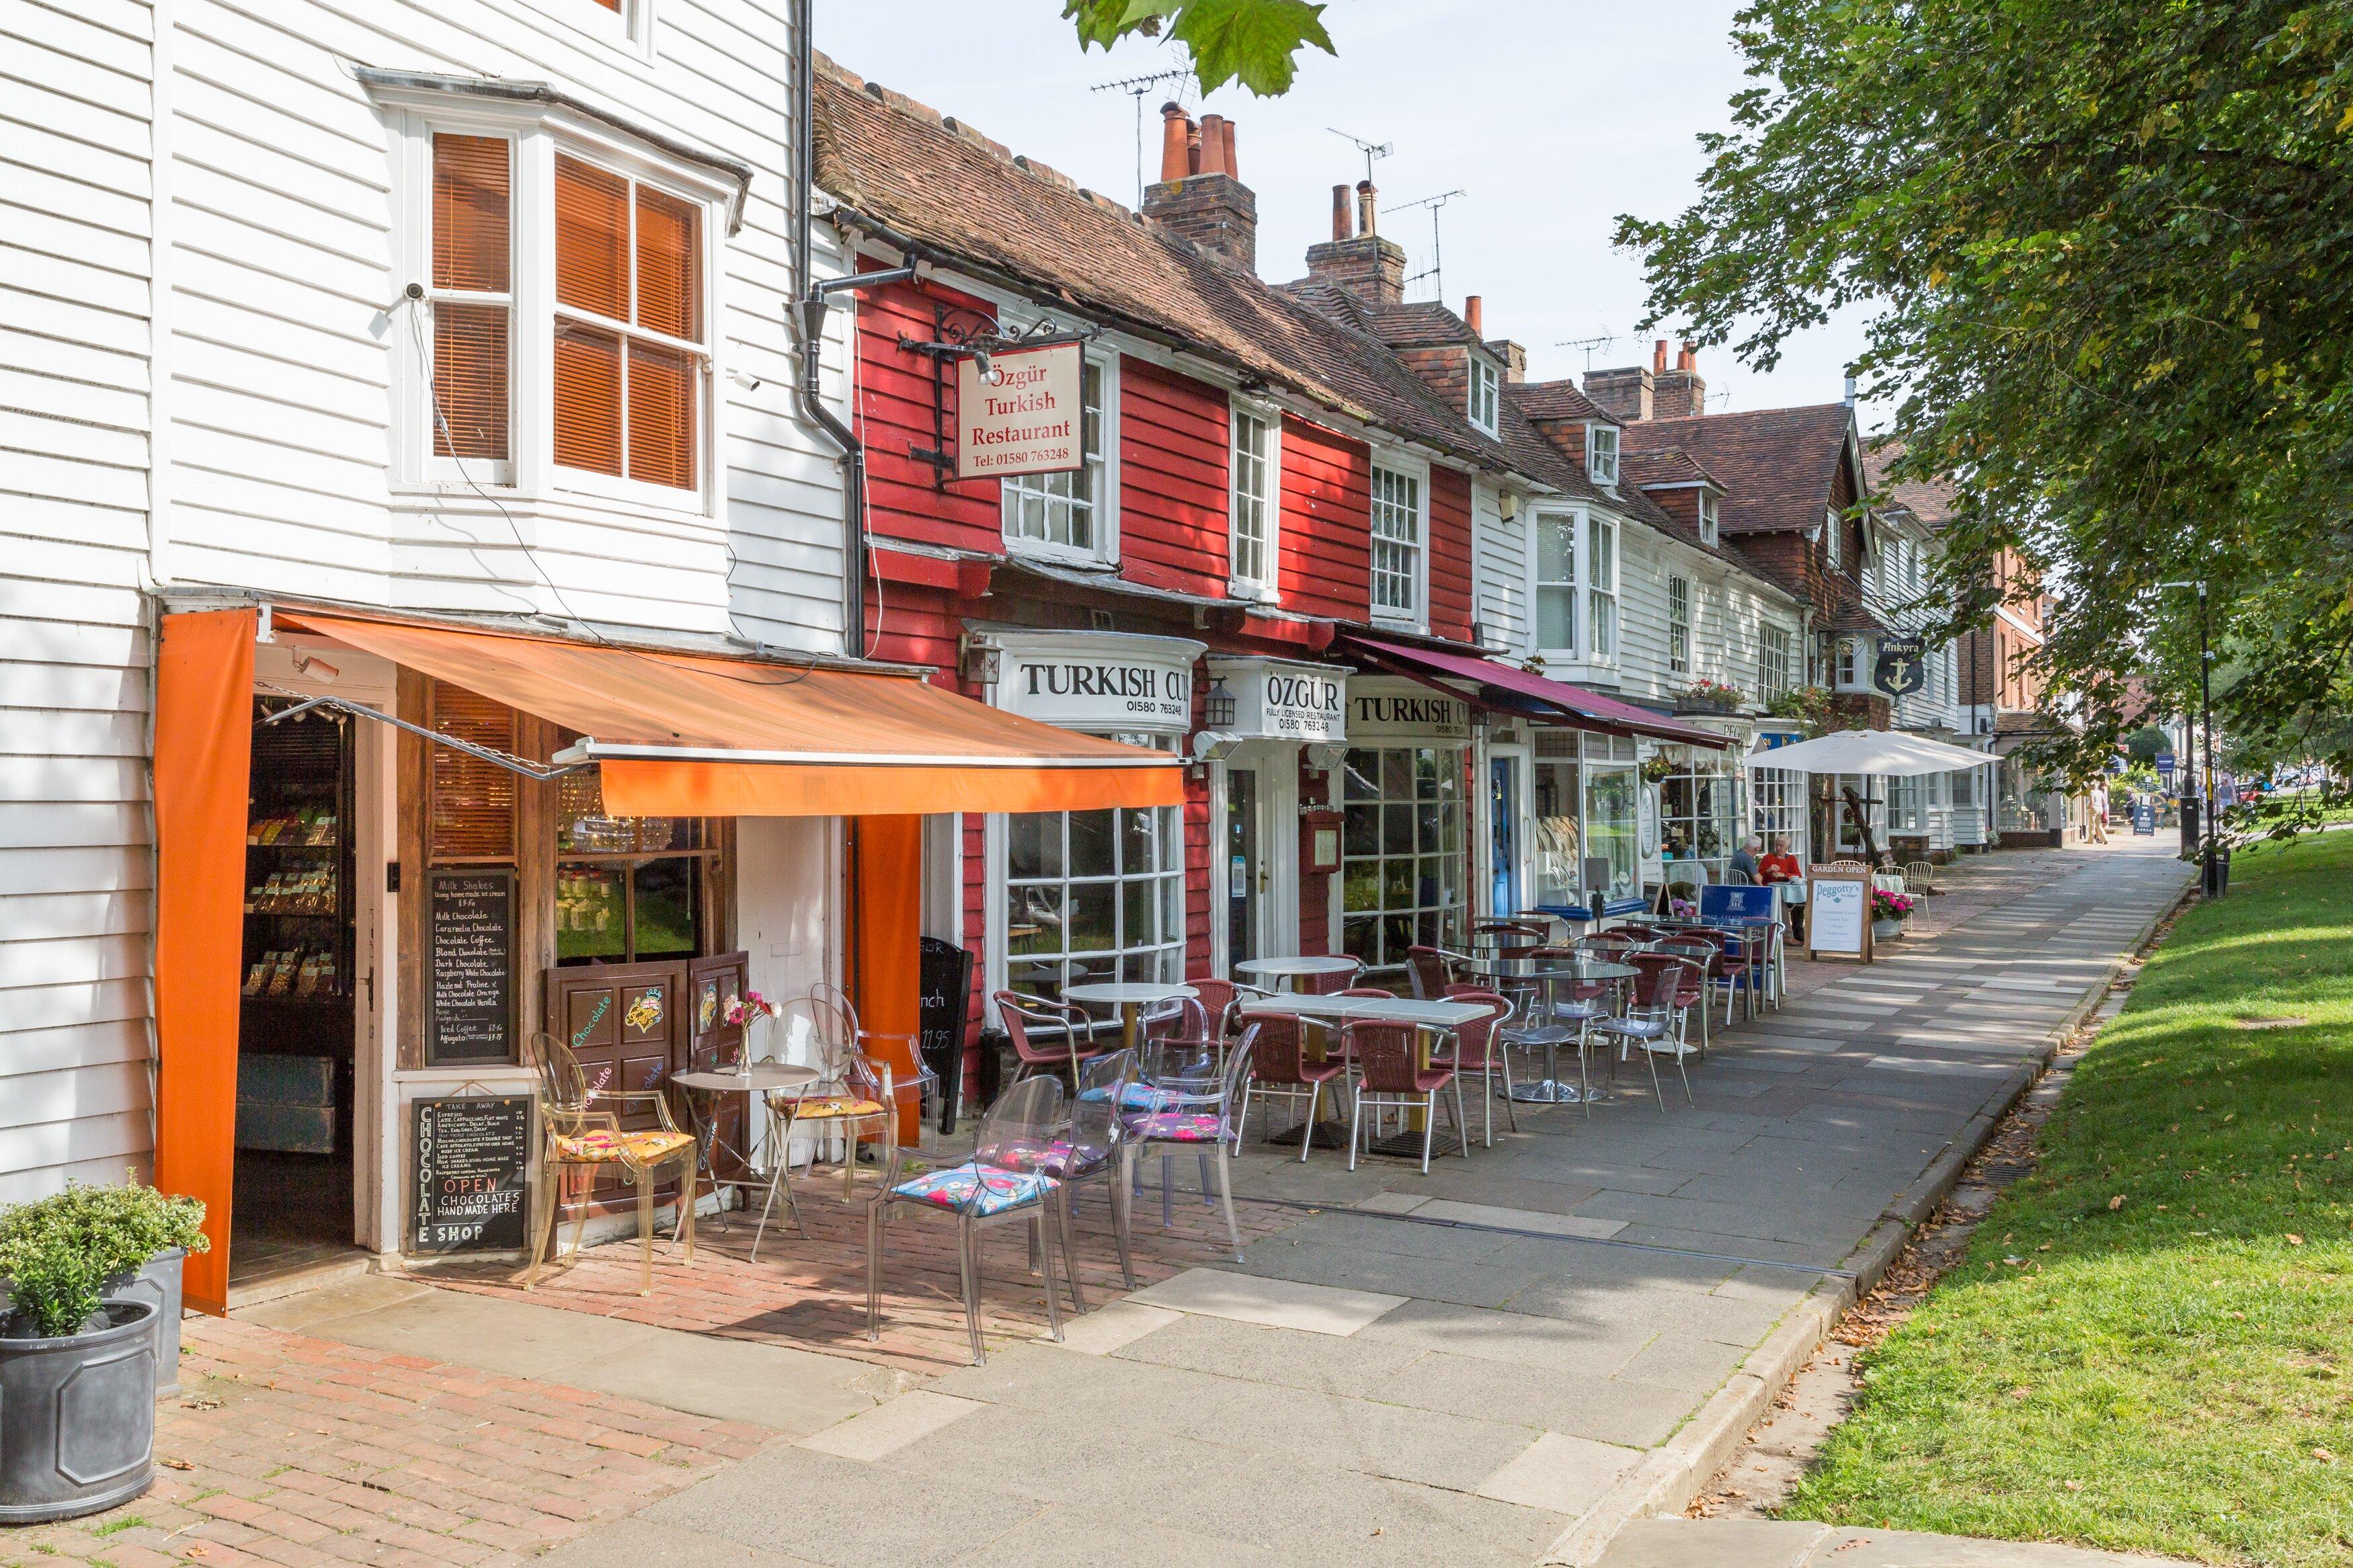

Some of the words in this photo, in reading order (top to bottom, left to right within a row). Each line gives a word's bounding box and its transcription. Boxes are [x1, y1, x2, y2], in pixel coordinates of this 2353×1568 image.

[991, 364, 1047, 390] Özgür
[985, 391, 1055, 415] Turkish
[972, 420, 1070, 446] Restaurant
[973, 455, 993, 467] Tel:
[996, 452, 1027, 465] 01580
[1031, 448, 1069, 462] 763248
[1883, 642, 1919, 655] Ankyra
[1021, 664, 1156, 698] TURKISH
[1268, 671, 1339, 711] ÖZGÜR
[1127, 700, 1156, 712] 01580
[1160, 703, 1181, 716] 763248
[1355, 698, 1450, 723] TURKISH
[1267, 708, 1279, 716] FULLY
[1281, 710, 1304, 718] LICENSED
[1307, 712, 1341, 722] RESTAURANT
[1279, 718, 1300, 730] 01580
[1304, 720, 1329, 732] 763248
[1436, 725, 1452, 733] 01580
[439, 881, 458, 890] Milk
[463, 880, 493, 890] Shakes
[434, 892, 449, 901] Using
[1816, 884, 1860, 901] Peggotty's
[436, 912, 450, 921] Milk
[452, 909, 488, 920] Chocolate
[473, 923, 504, 932] Chocolate
[436, 936, 469, 944] Chocolate
[471, 935, 494, 946] Coffee
[435, 948, 457, 956] Blond
[459, 947, 488, 956] Chocolate
[435, 959, 452, 967] Dark
[456, 959, 489, 968] Chocolate
[435, 969, 465, 980] Raspberry
[467, 980, 490, 988] Praline
[448, 989, 475, 997] Chocolate
[477, 989, 500, 998] Orange
[451, 999, 476, 1007] Chocolate
[477, 998, 497, 1006] Vanilla
[573, 996, 611, 1046] Chocolate
[440, 1024, 454, 1033] Iced
[456, 1024, 477, 1034] Coffee
[440, 1034, 465, 1044] Affogato
[444, 1178, 497, 1193] OPEN
[442, 1192, 520, 1206] CHOCOLATES
[492, 1202, 517, 1213] HERE
[438, 1226, 483, 1241] SHOP
